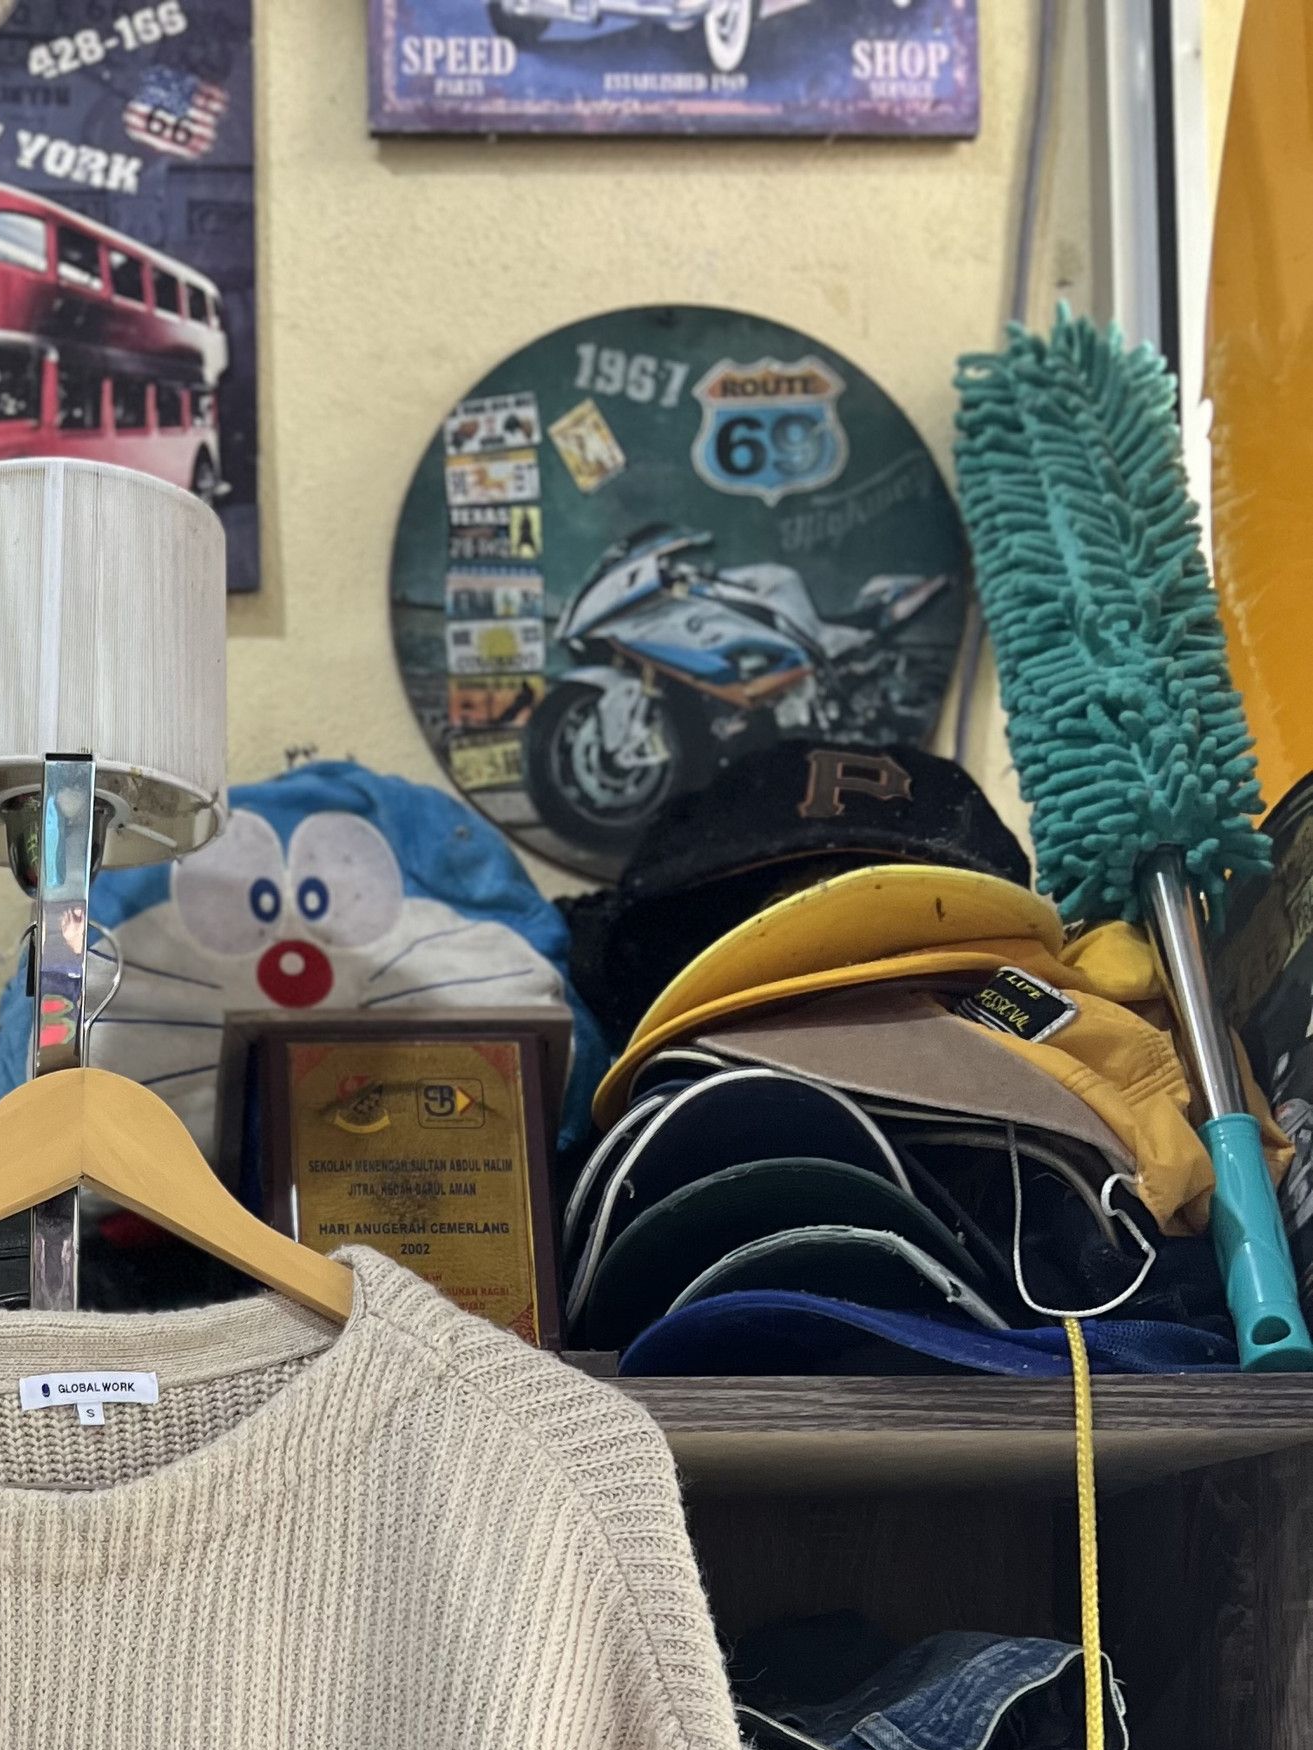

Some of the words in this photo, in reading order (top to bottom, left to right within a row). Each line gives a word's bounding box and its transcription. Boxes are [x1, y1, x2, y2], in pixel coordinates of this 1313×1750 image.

[401, 36, 517, 76] SPEED
[851, 38, 950, 80] SHOP
[145, 106, 193, 144] 66
[15, 129, 143, 192] YORK
[720, 375, 816, 397] ROUTE
[798, 750, 913, 819] P
[308, 1158, 352, 1174] SEKOLAH
[449, 1157, 481, 1172] ABDUL
[483, 1157, 514, 1172] HALIM
[448, 1182, 477, 1197] AMAN
[318, 1223, 350, 1236] HARI
[354, 1222, 427, 1235] ANUGERAH
[430, 1222, 511, 1235] CEMERLANG
[400, 1243, 431, 1256] 2002
[57, 1382, 100, 1393] GLOBAL
[102, 1382, 136, 1393] WORK
[86, 1408, 96, 1418] S
